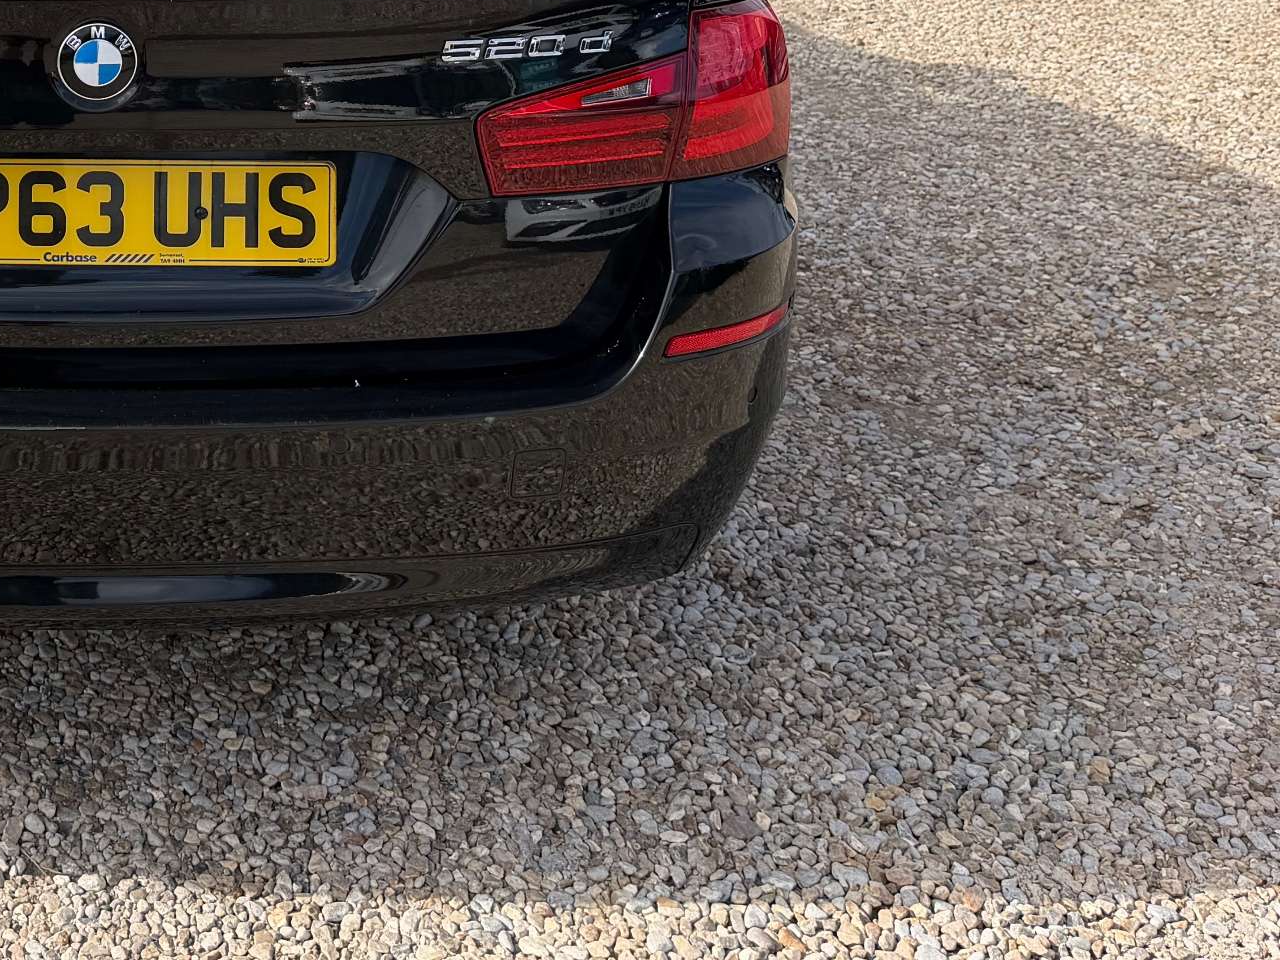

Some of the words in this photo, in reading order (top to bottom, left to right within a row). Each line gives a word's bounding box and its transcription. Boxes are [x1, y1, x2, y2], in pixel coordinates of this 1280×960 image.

[65, 26, 132, 53] BMW
[153, 171, 317, 249] UHS
[42, 251, 97, 263] Carbase
